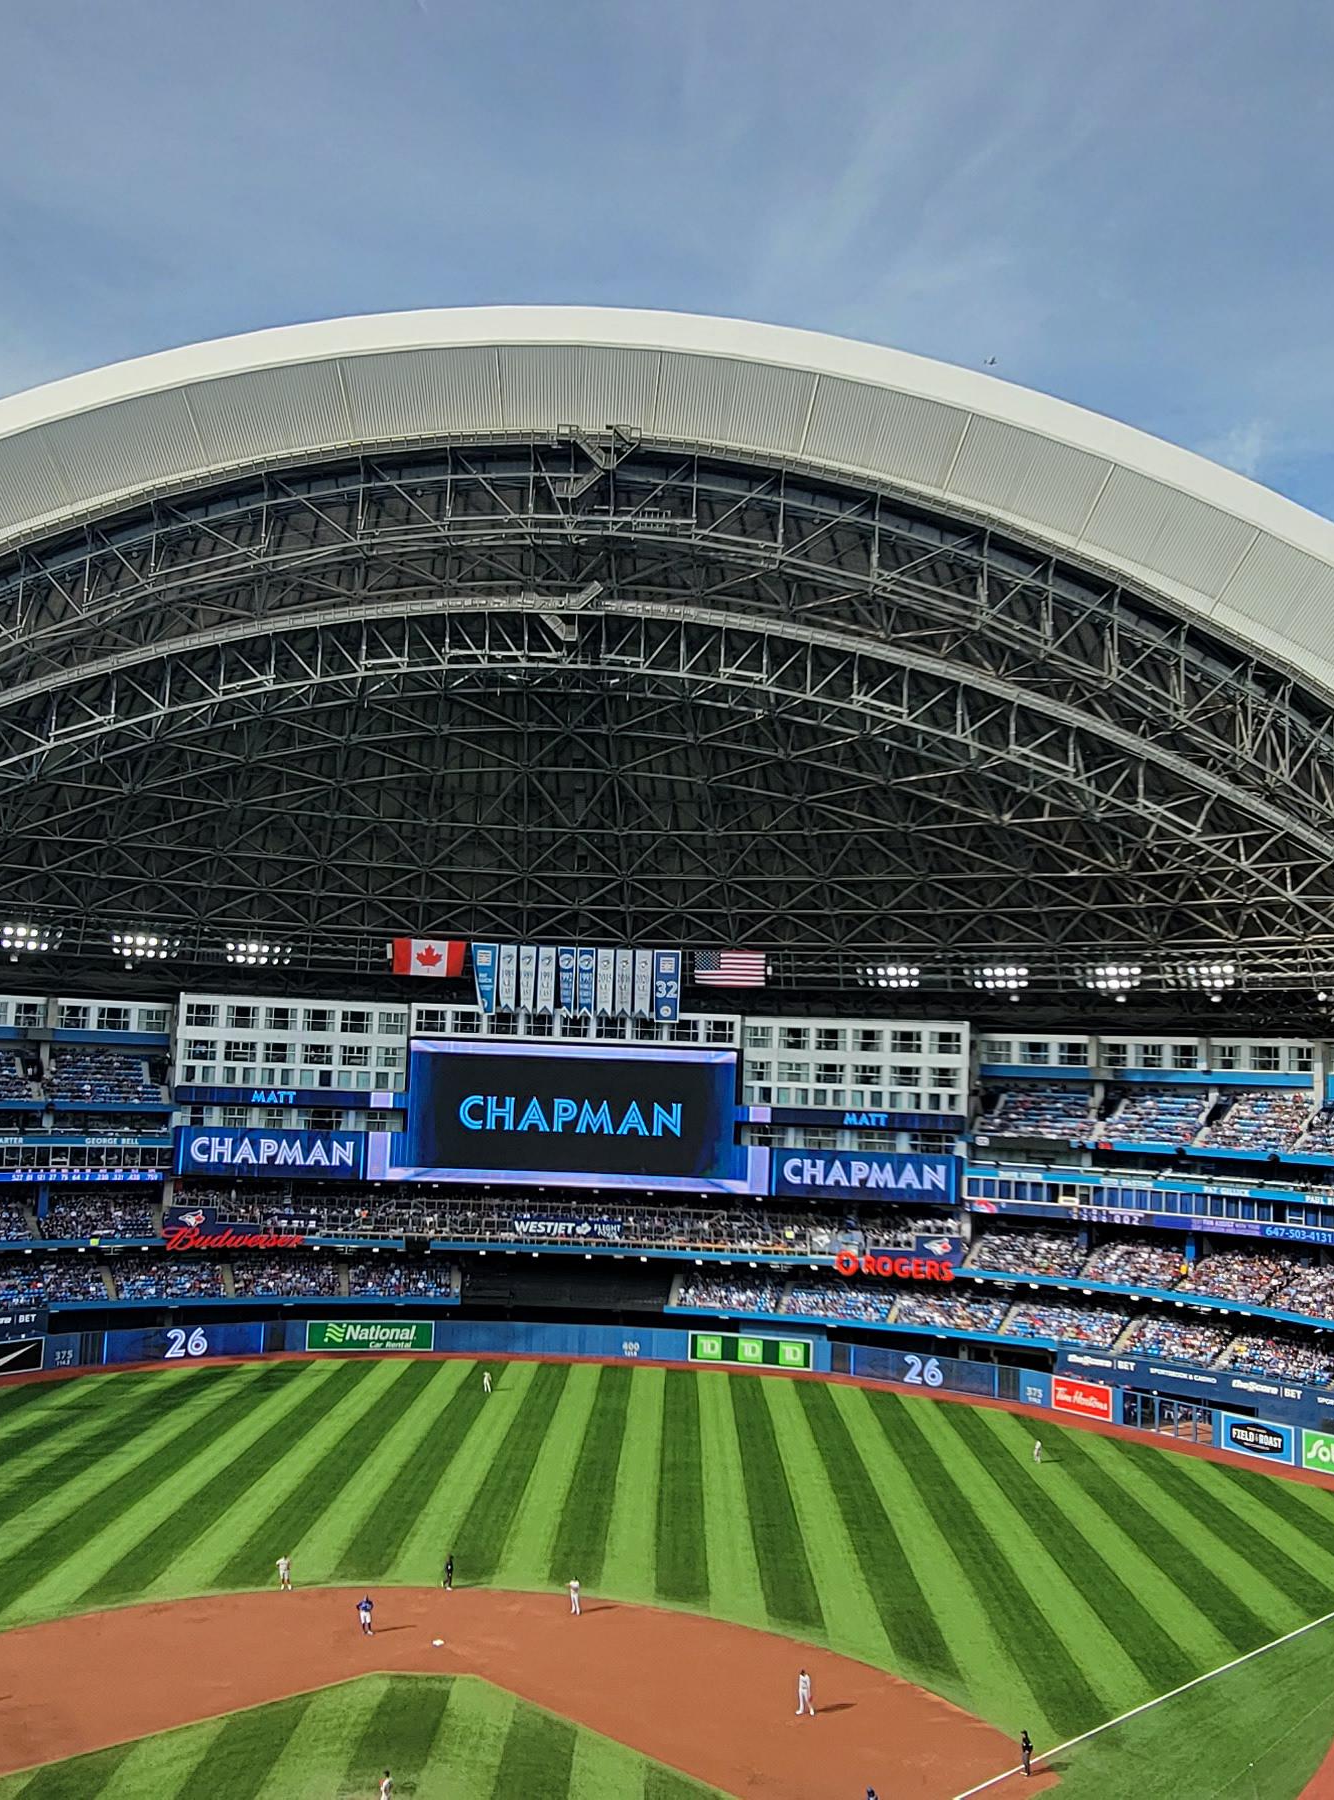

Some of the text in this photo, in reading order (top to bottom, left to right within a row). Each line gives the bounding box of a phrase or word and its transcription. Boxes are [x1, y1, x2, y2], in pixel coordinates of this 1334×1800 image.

[655, 980, 678, 999] 32
[251, 1090, 296, 1104] MATT
[459, 1094, 683, 1138] CHAPMAN
[843, 1112, 888, 1127] MATT
[85, 1137, 118, 1145] GEORGE
[190, 1136, 356, 1167] CHAPMAN
[783, 1157, 948, 1192] CHAPMAN
[1305, 1195, 1325, 1204] PAUL
[514, 1220, 621, 1236] WESTJET FLIGHT
[1265, 1226, 1333, 1244] 647-503-4131
[161, 1226, 304, 1250] Budweiser
[862, 1254, 955, 1282] ROGERS
[18, 1314, 36, 1323] BET
[164, 1326, 208, 1359] 26
[622, 1341, 640, 1351] 400
[700, 1340, 721, 1354] TD
[742, 1342, 761, 1357] TD
[55, 1350, 73, 1360] 375
[784, 1345, 802, 1361] TD
[903, 1355, 944, 1387] 26
[1118, 1361, 1136, 1371] BET
[1026, 1386, 1043, 1398] 375
[1231, 1379, 1303, 1400] theScore BET
[1055, 1387, 1108, 1411] Tim Hortons
[1232, 1427, 1255, 1443] FIELD
[1258, 1433, 1283, 1449] ROAST
